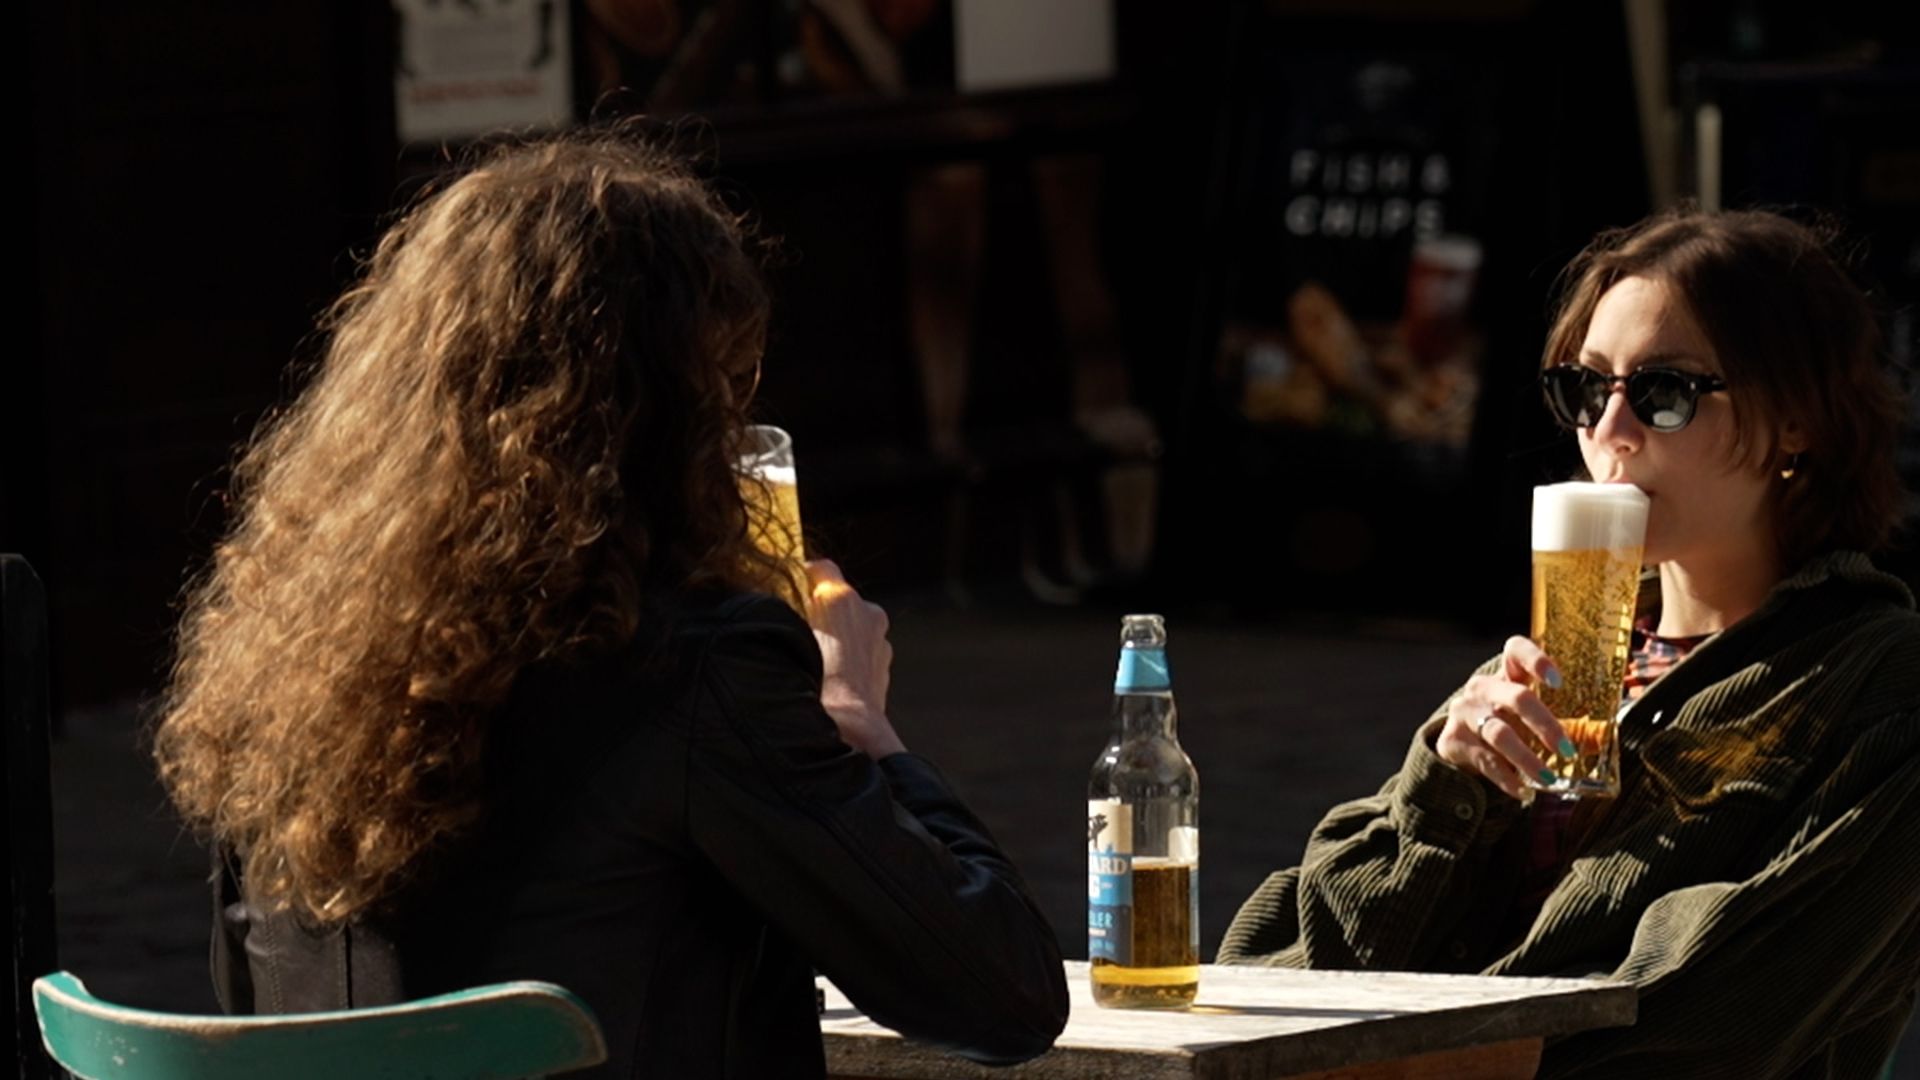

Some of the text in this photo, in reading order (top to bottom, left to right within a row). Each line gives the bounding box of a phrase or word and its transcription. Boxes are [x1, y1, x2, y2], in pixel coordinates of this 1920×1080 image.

[1290, 150, 1411, 192] FISH
[1285, 195, 1443, 240] CHIPS
[1088, 856, 1128, 875] ARD
